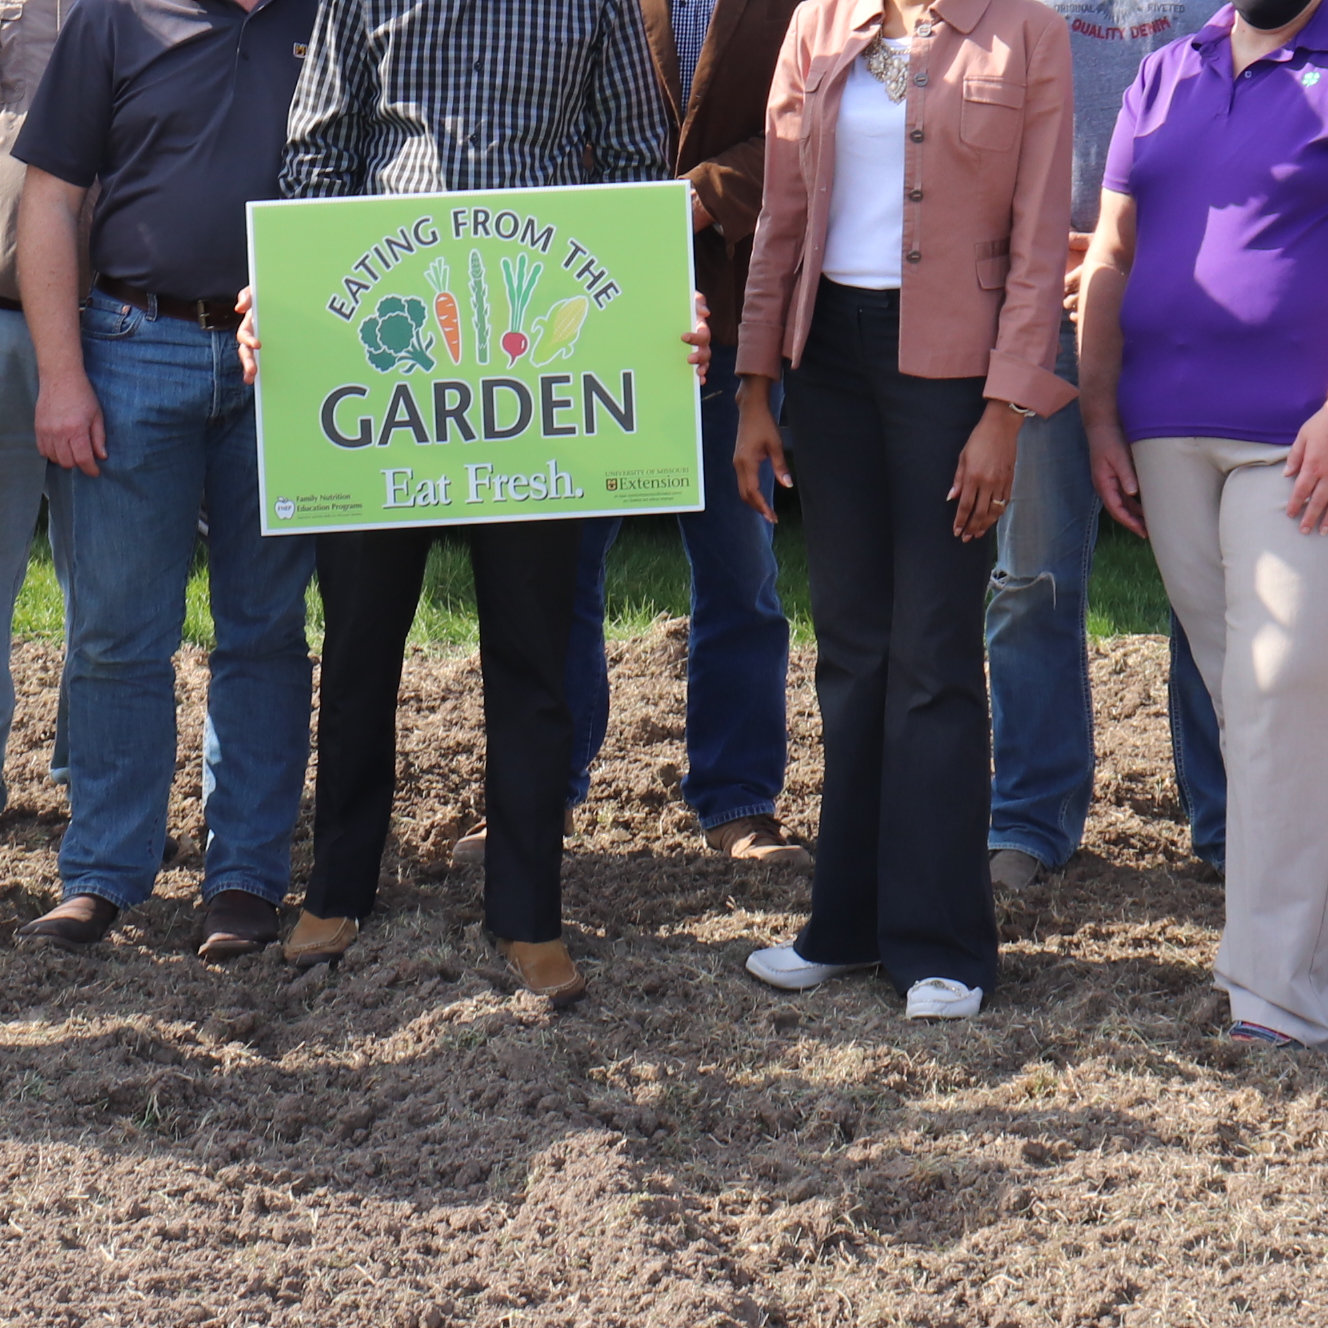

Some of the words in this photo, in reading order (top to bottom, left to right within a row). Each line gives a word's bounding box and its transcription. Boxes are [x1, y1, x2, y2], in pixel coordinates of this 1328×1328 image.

[1147, 3, 1185, 14] RIVETED
[1072, 18, 1125, 40] QUALITY
[1130, 16, 1171, 39] DENIM
[327, 216, 439, 322] EATING
[451, 208, 555, 253] FROM
[562, 239, 621, 310] THE
[320, 370, 636, 449] GARDEN
[380, 467, 452, 509] Eat
[463, 459, 584, 504] Fresh.
[619, 475, 690, 491] Extension
[296, 494, 318, 503] Family
[320, 493, 351, 501] Nutrition
[296, 504, 330, 512] Education
[331, 503, 363, 512] Programs
